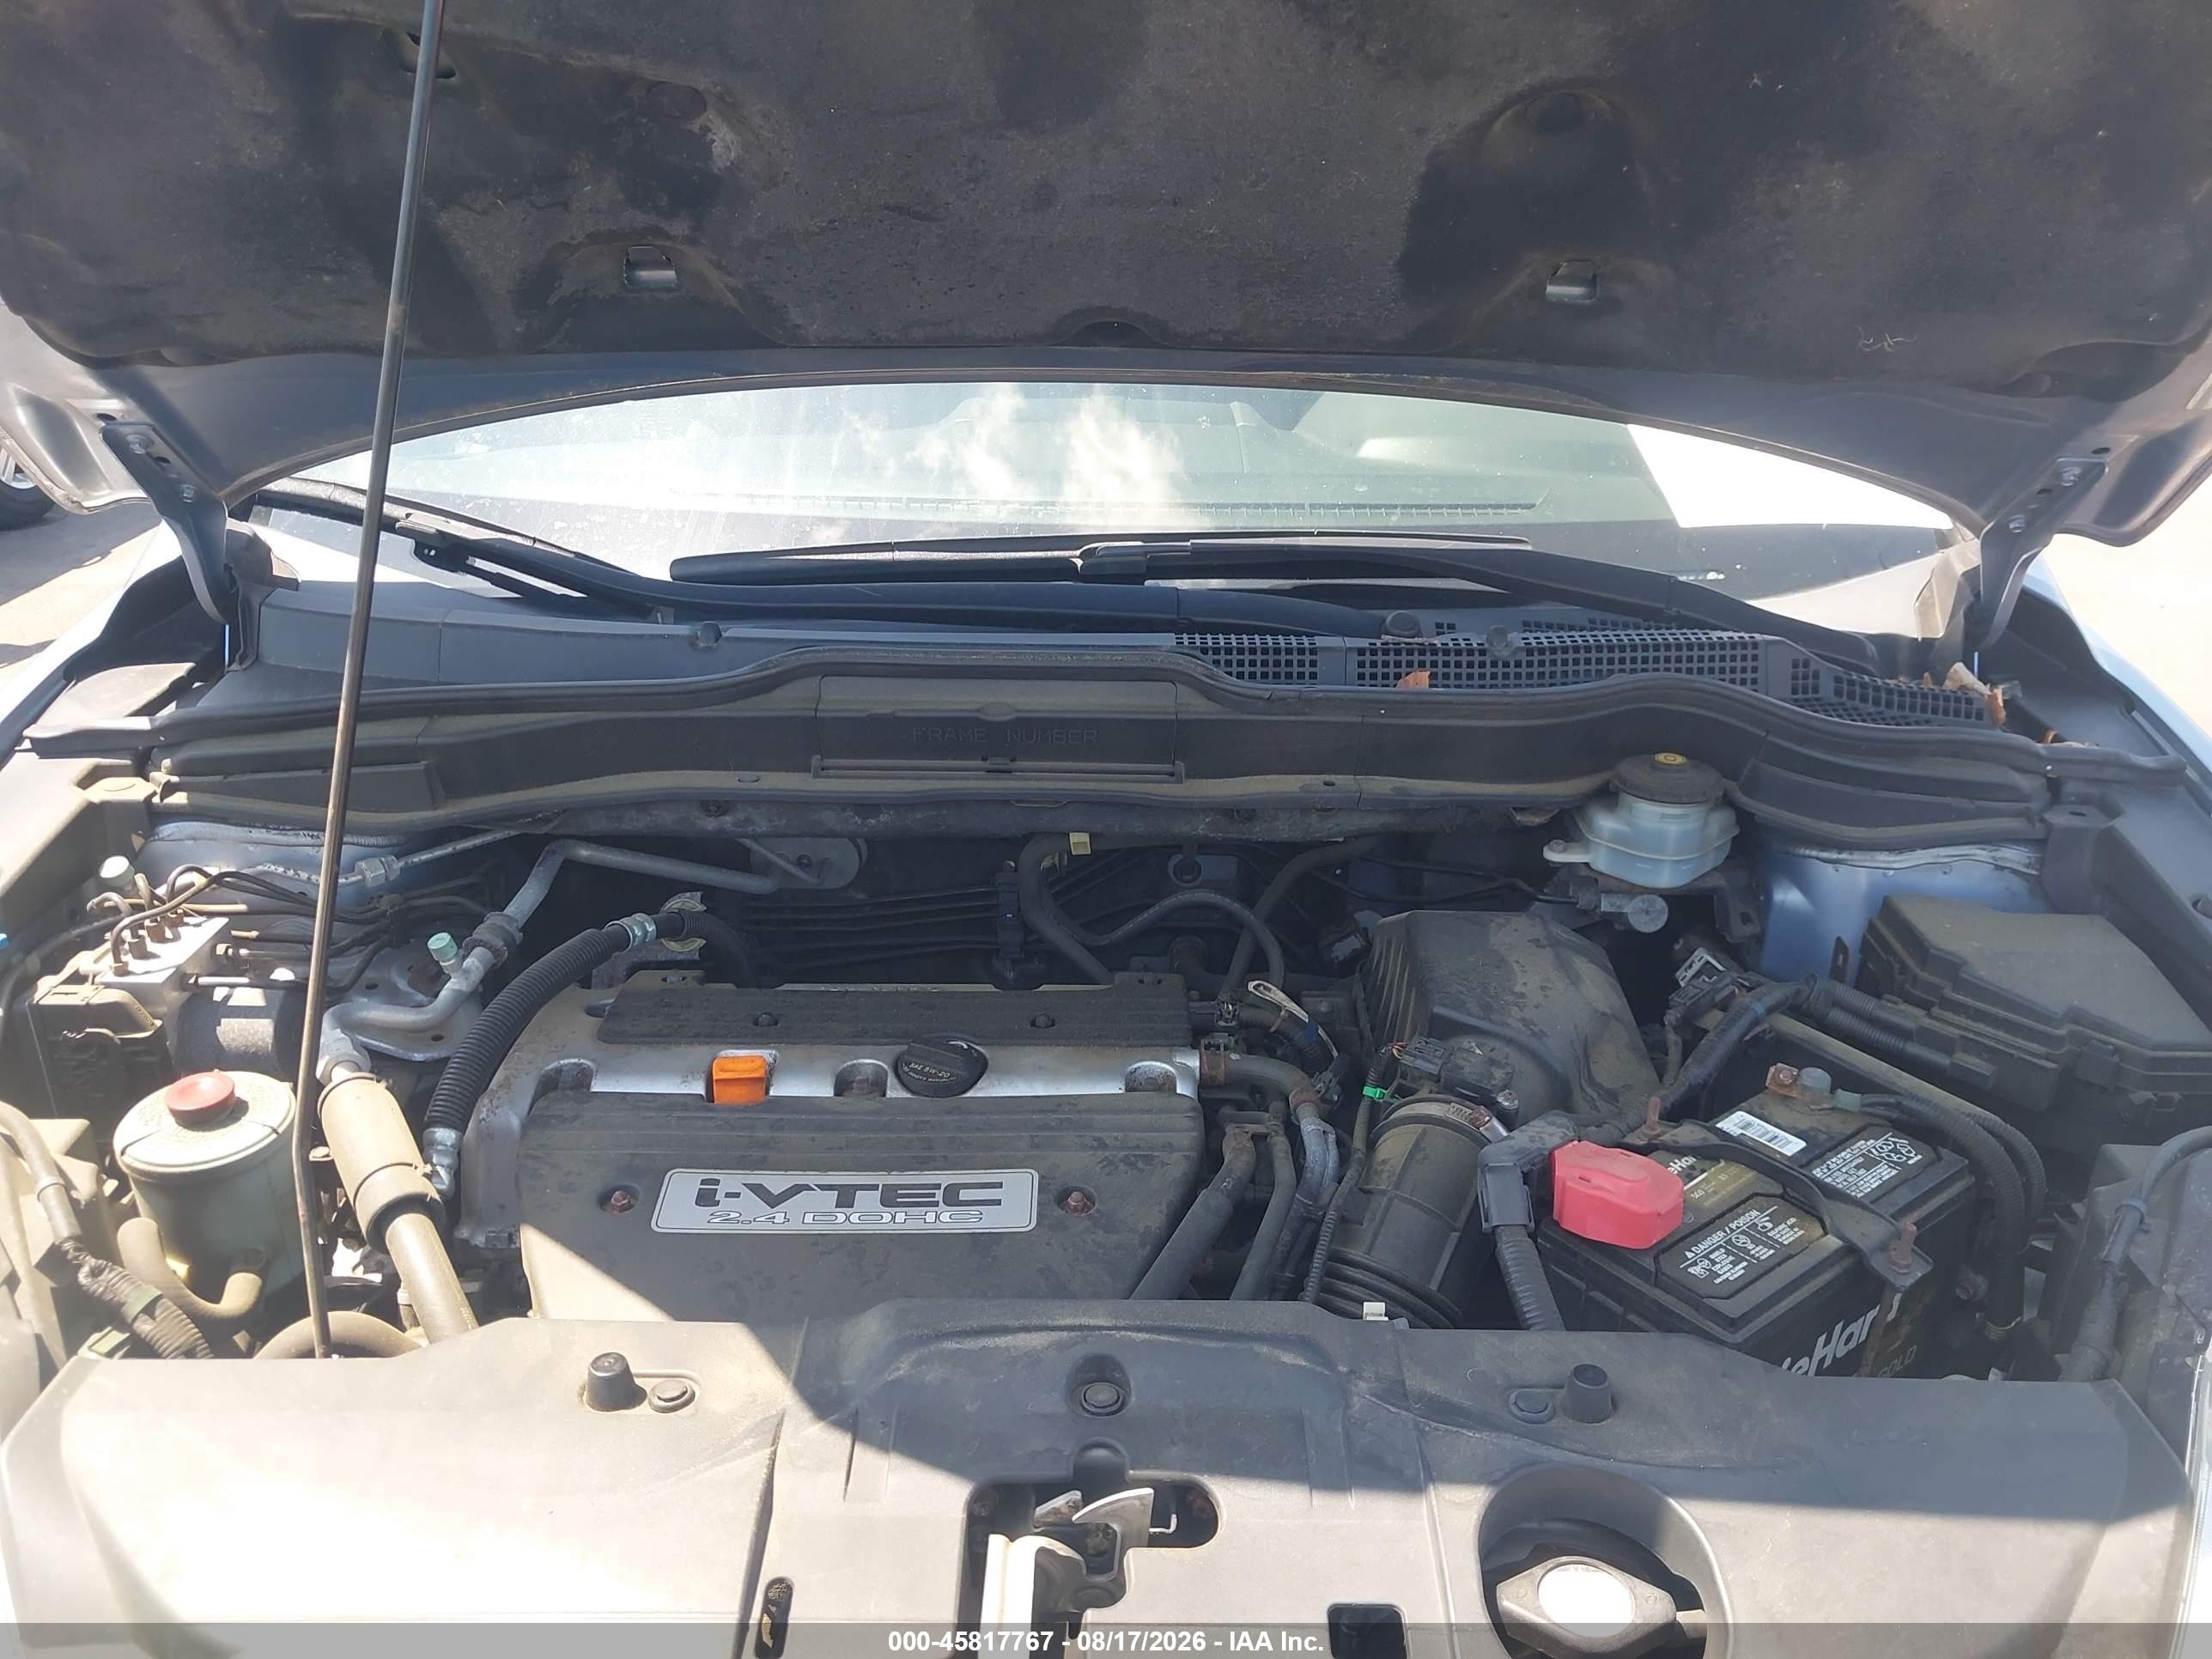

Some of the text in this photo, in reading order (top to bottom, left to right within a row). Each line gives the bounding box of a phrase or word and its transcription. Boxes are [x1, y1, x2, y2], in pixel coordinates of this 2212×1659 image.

[913, 727, 1098, 744] FRAME NUMBER
[908, 1062, 924, 1071] SAE
[694, 1177, 1004, 1210] i-VTEC
[707, 1211, 983, 1224] 2.4 DOHC
[1691, 1230, 1728, 1255] DANGER
[1728, 1208, 1761, 1231] POISON
